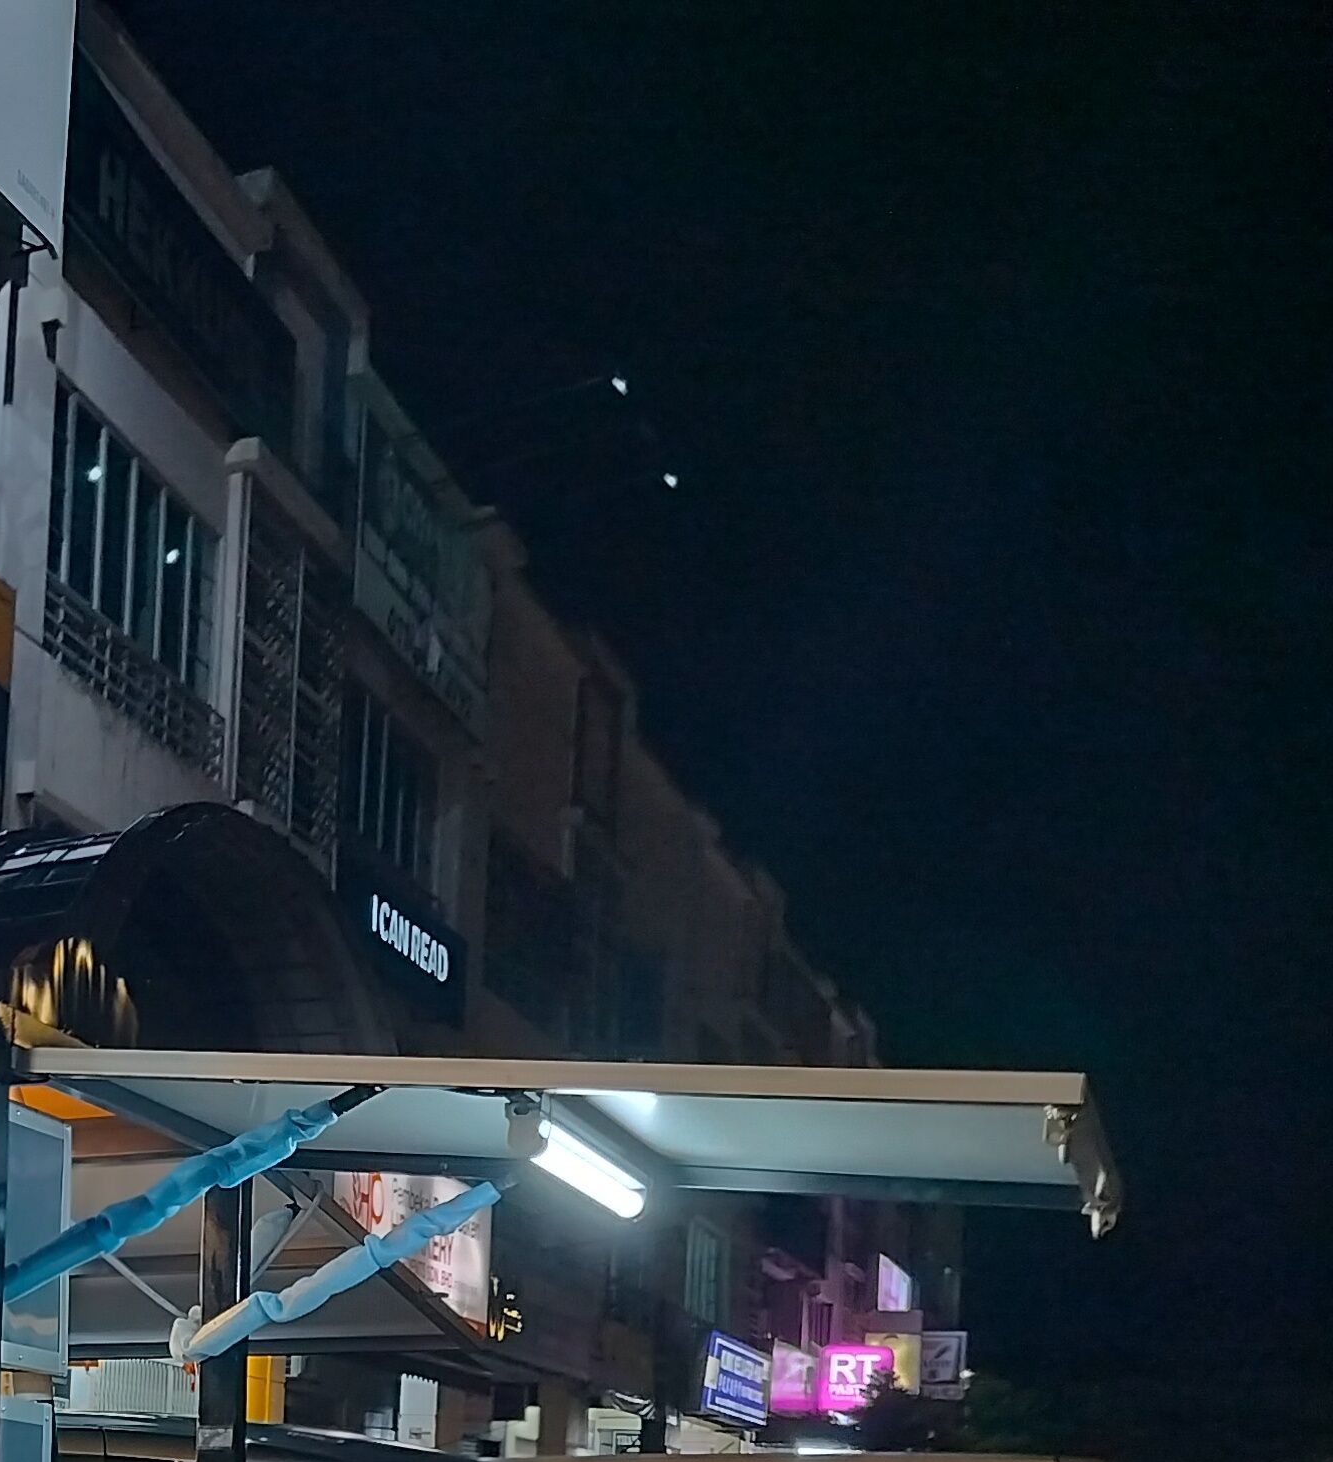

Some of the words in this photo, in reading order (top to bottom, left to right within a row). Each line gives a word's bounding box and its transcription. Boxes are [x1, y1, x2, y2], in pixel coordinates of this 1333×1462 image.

[371, 894, 379, 932] I
[379, 901, 409, 957] CAN
[410, 924, 449, 983] READ
[829, 1353, 882, 1385] RT
